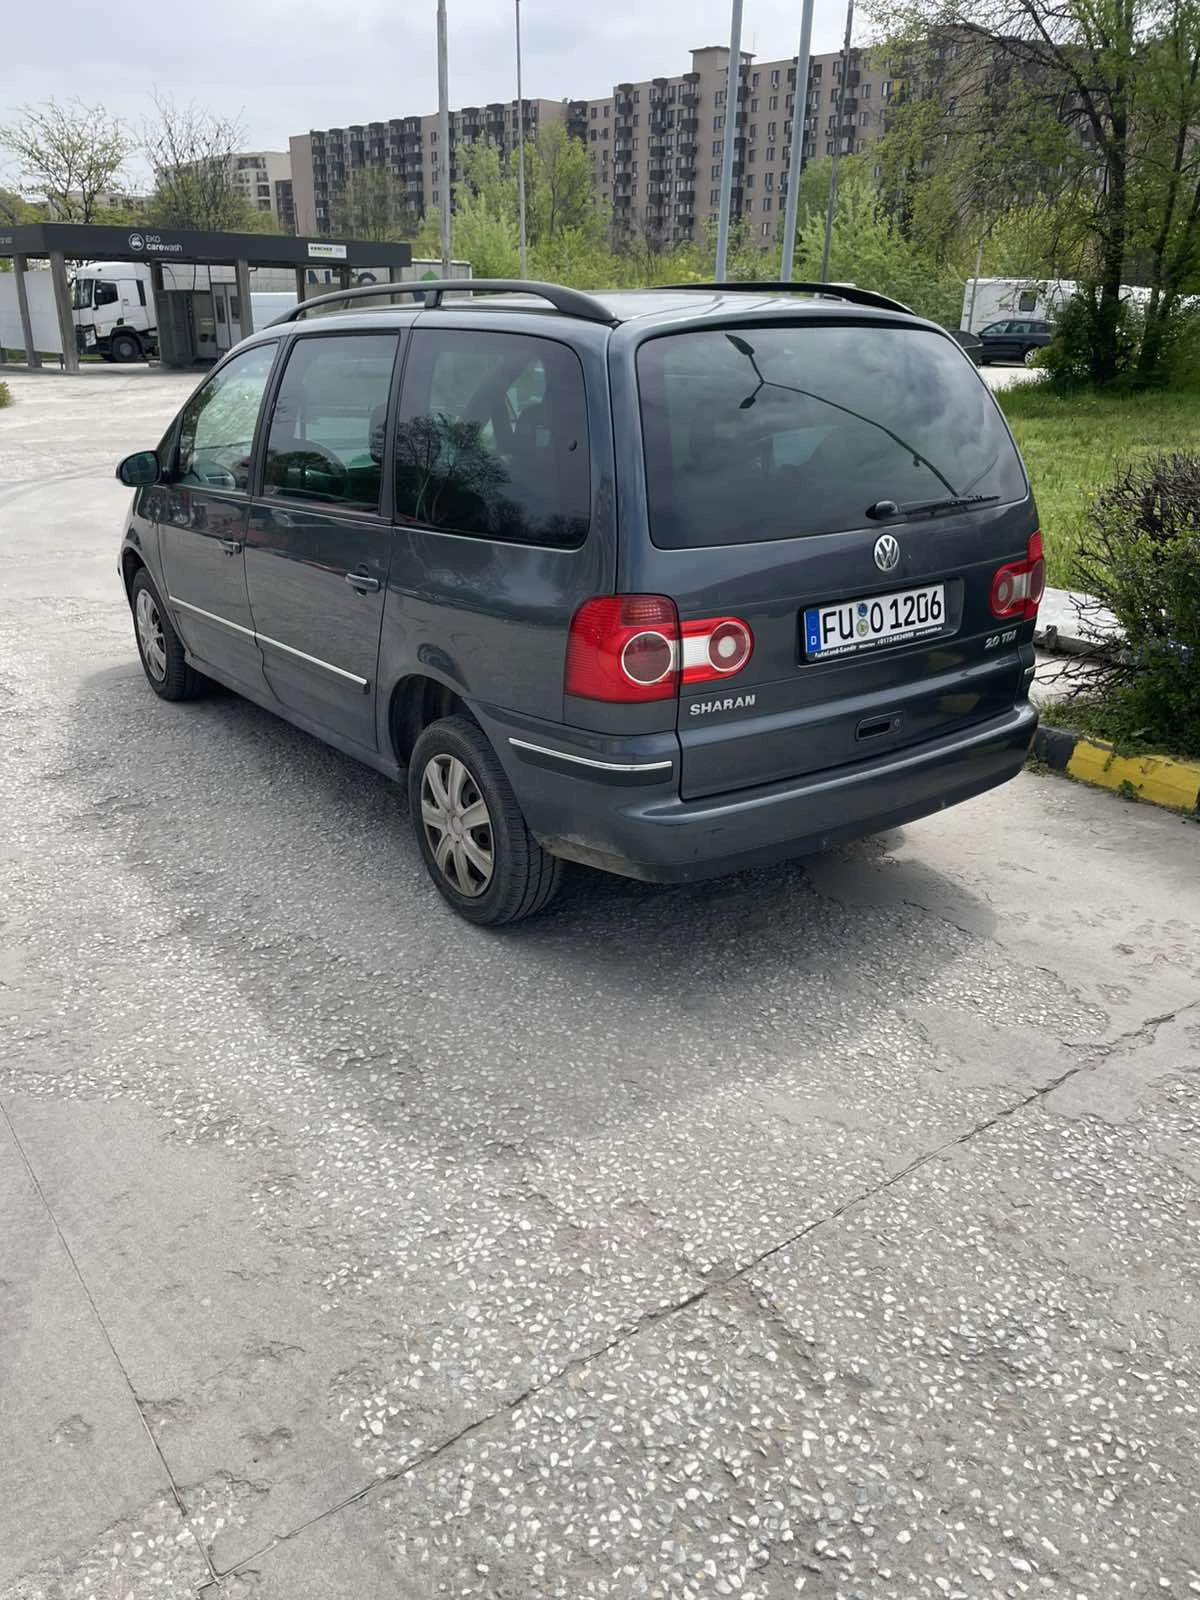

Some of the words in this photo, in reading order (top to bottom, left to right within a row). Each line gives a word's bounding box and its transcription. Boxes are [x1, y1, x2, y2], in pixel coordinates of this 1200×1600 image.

[145, 235, 161, 243] EKO
[146, 243, 183, 252] carewash
[822, 607, 854, 645] FU
[889, 590, 942, 630] 1206
[1001, 629, 1017, 644] TDI
[689, 694, 756, 715] SHARAN
